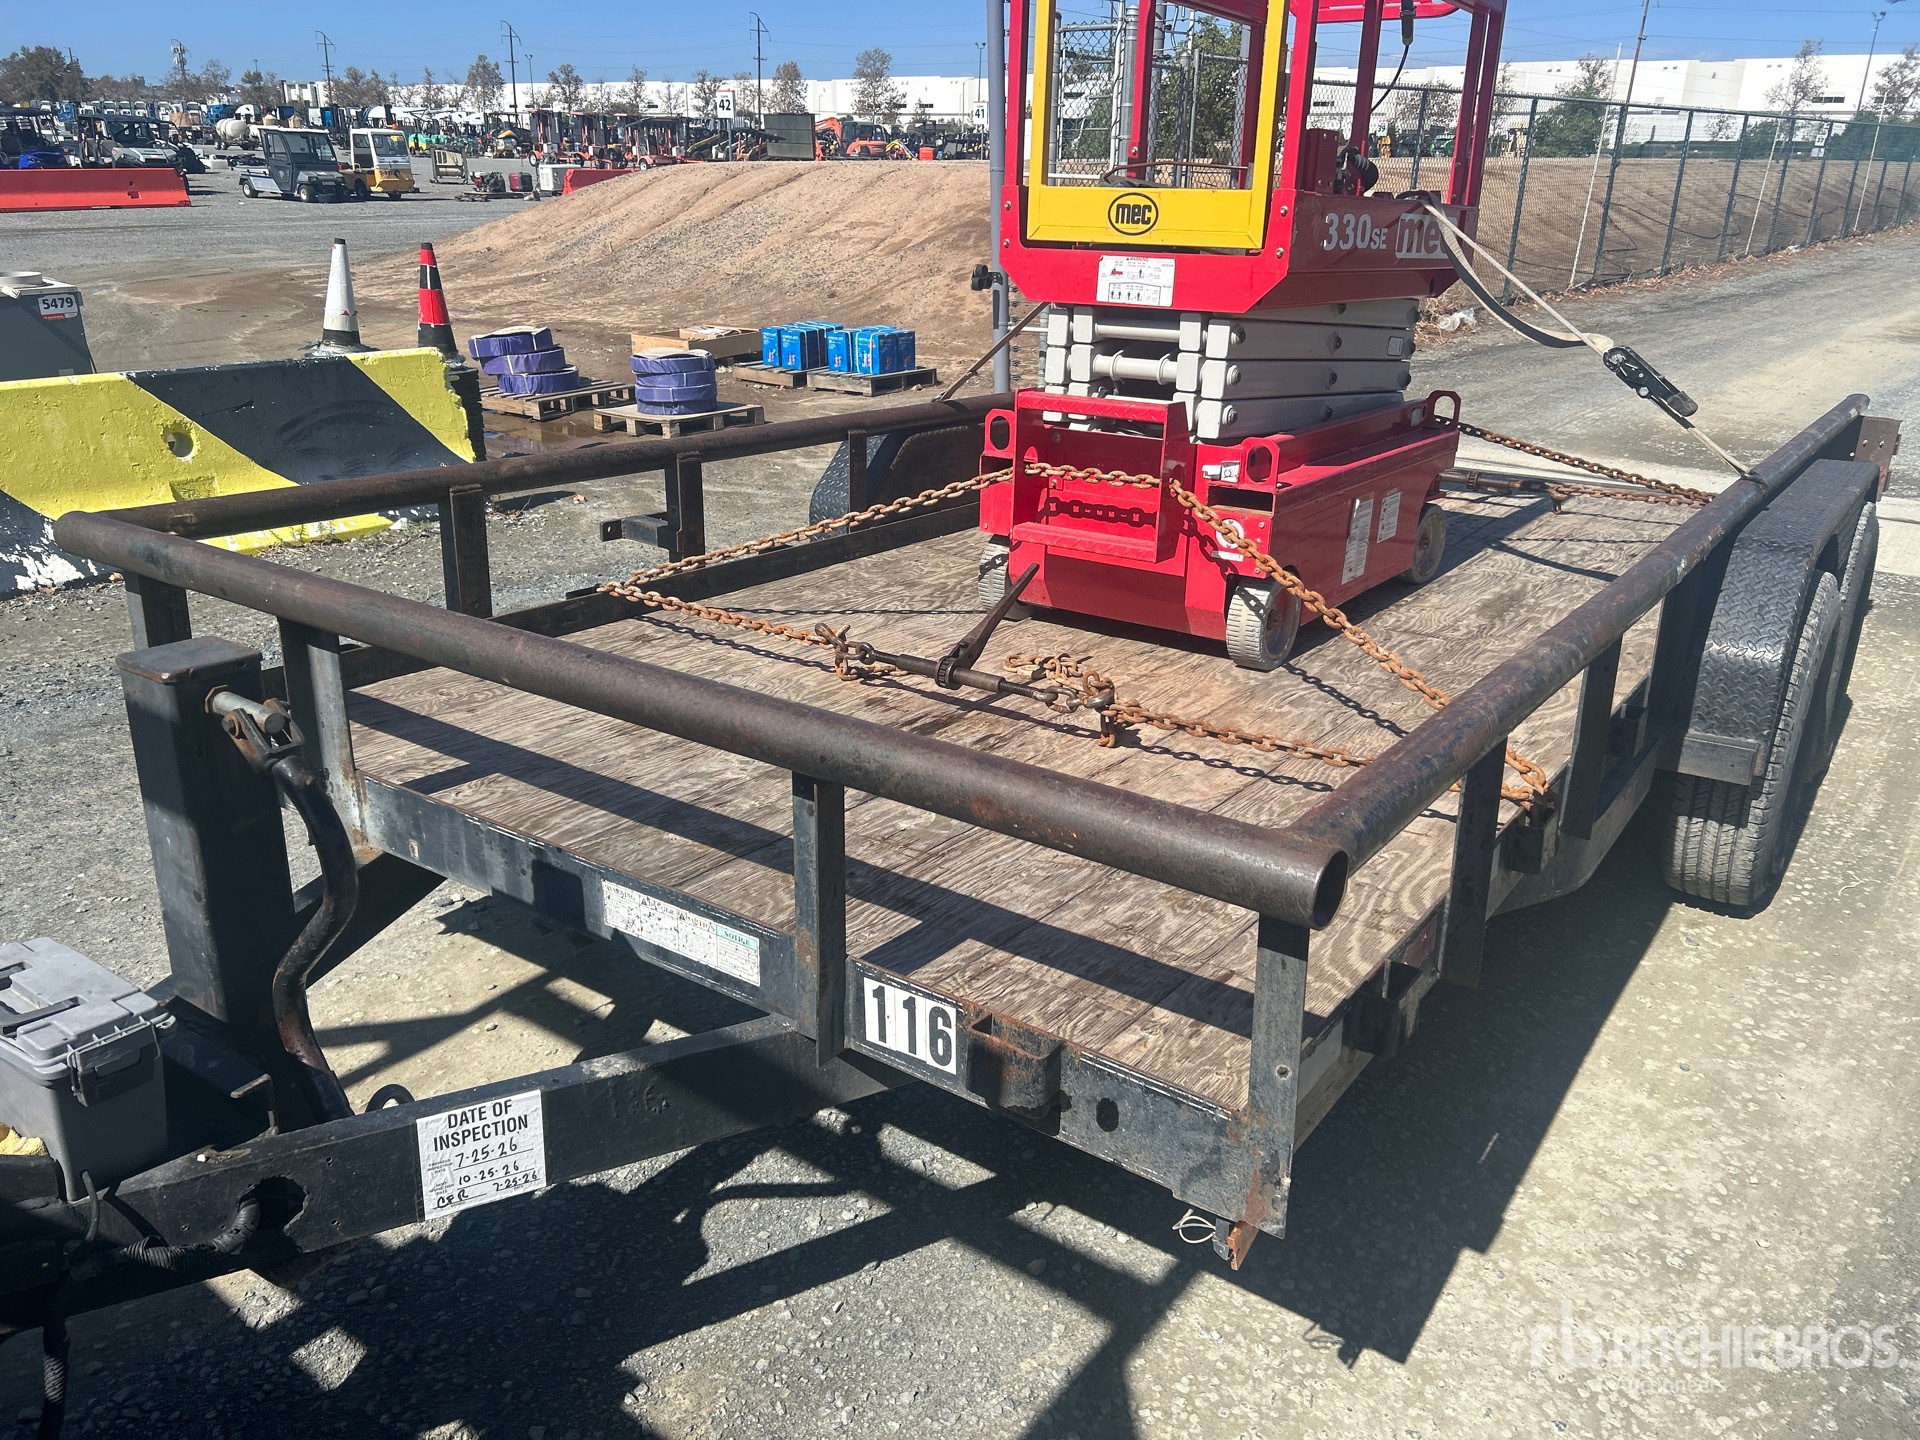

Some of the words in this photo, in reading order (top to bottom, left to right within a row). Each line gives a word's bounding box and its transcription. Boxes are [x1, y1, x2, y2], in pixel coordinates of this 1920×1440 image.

[719, 99, 731, 111] 42
[975, 108, 985, 118] 41
[1115, 203, 1152, 225] mec
[42, 297, 73, 309] 5479
[872, 984, 952, 1067] 116
[447, 1106, 487, 1129] DATE
[493, 1099, 512, 1117] OF
[434, 1114, 528, 1152] INSPECTION
